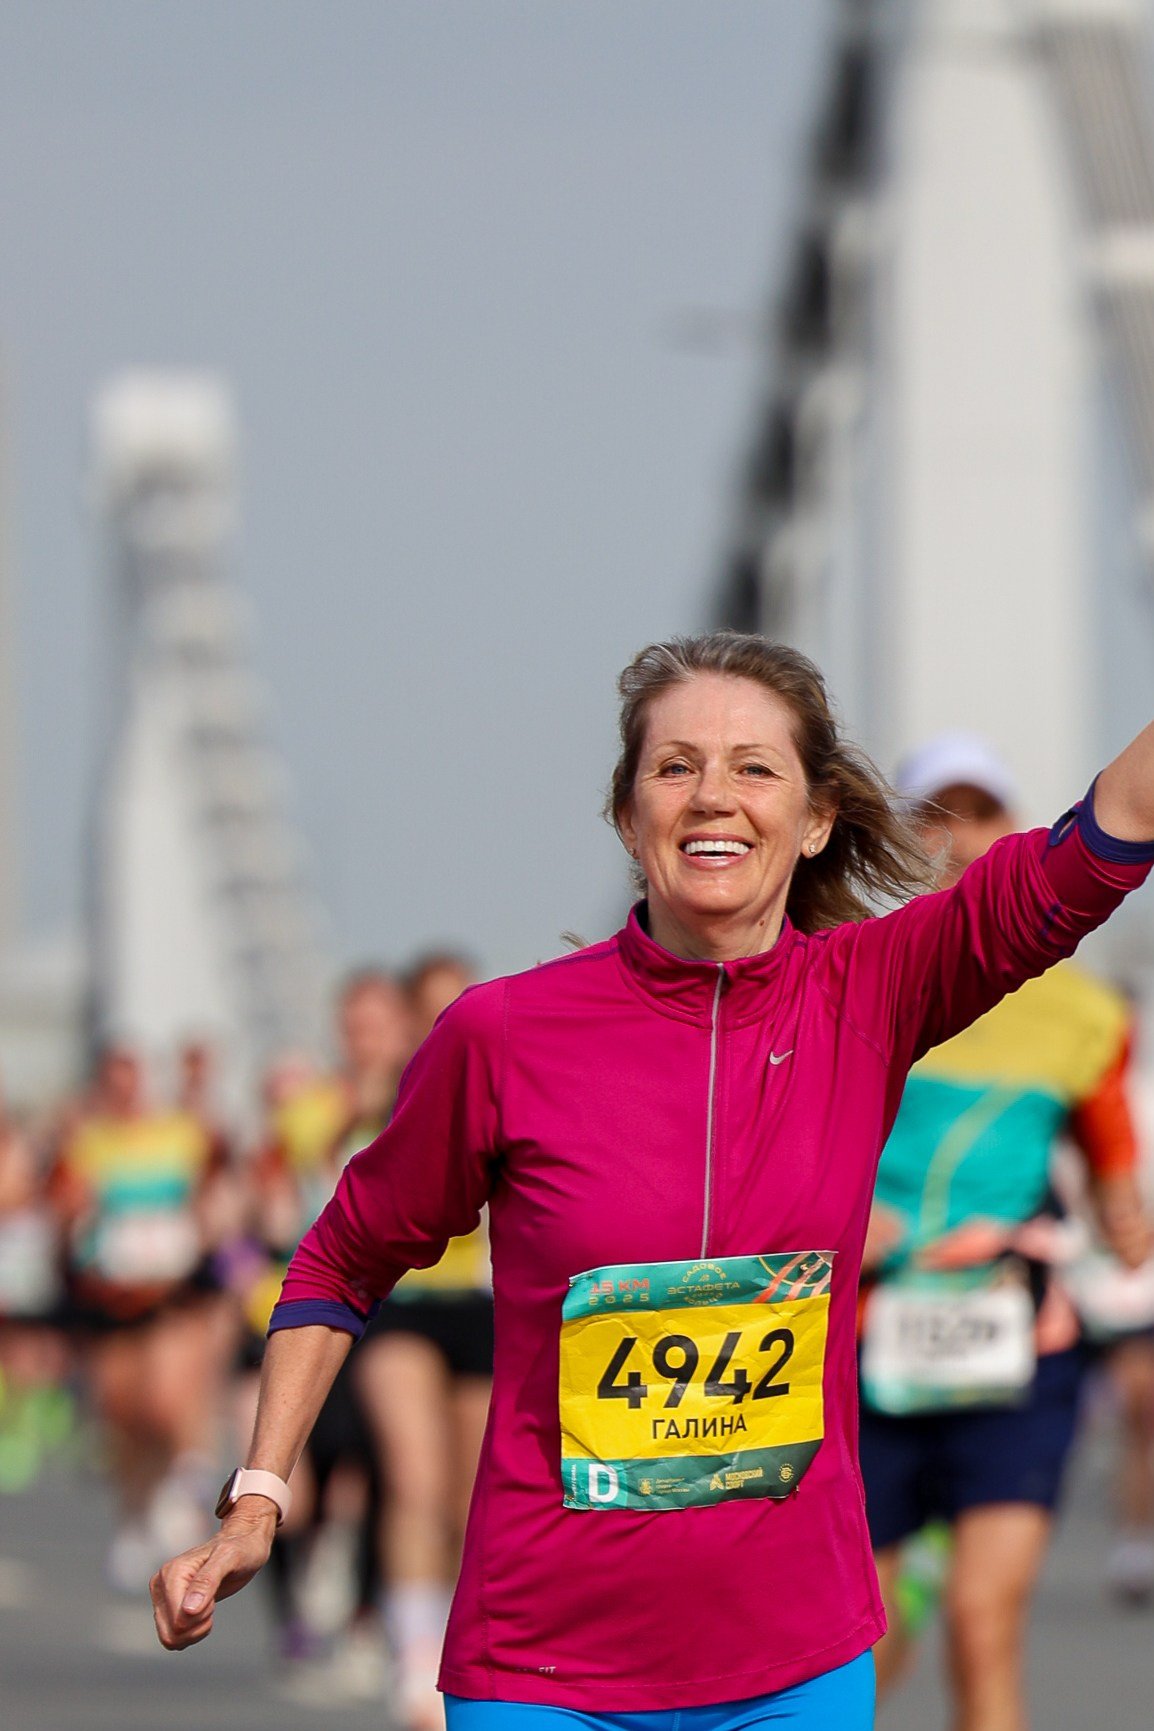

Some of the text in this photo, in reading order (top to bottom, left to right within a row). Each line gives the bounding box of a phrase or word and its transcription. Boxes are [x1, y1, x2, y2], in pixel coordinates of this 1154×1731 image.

[590, 1280, 614, 1295] 15
[667, 1281, 741, 1295] ЭСТАФЕТА
[597, 1328, 795, 1409] 4942
[652, 1413, 748, 1439] ГАЛИНА
[588, 1463, 619, 1503] D
